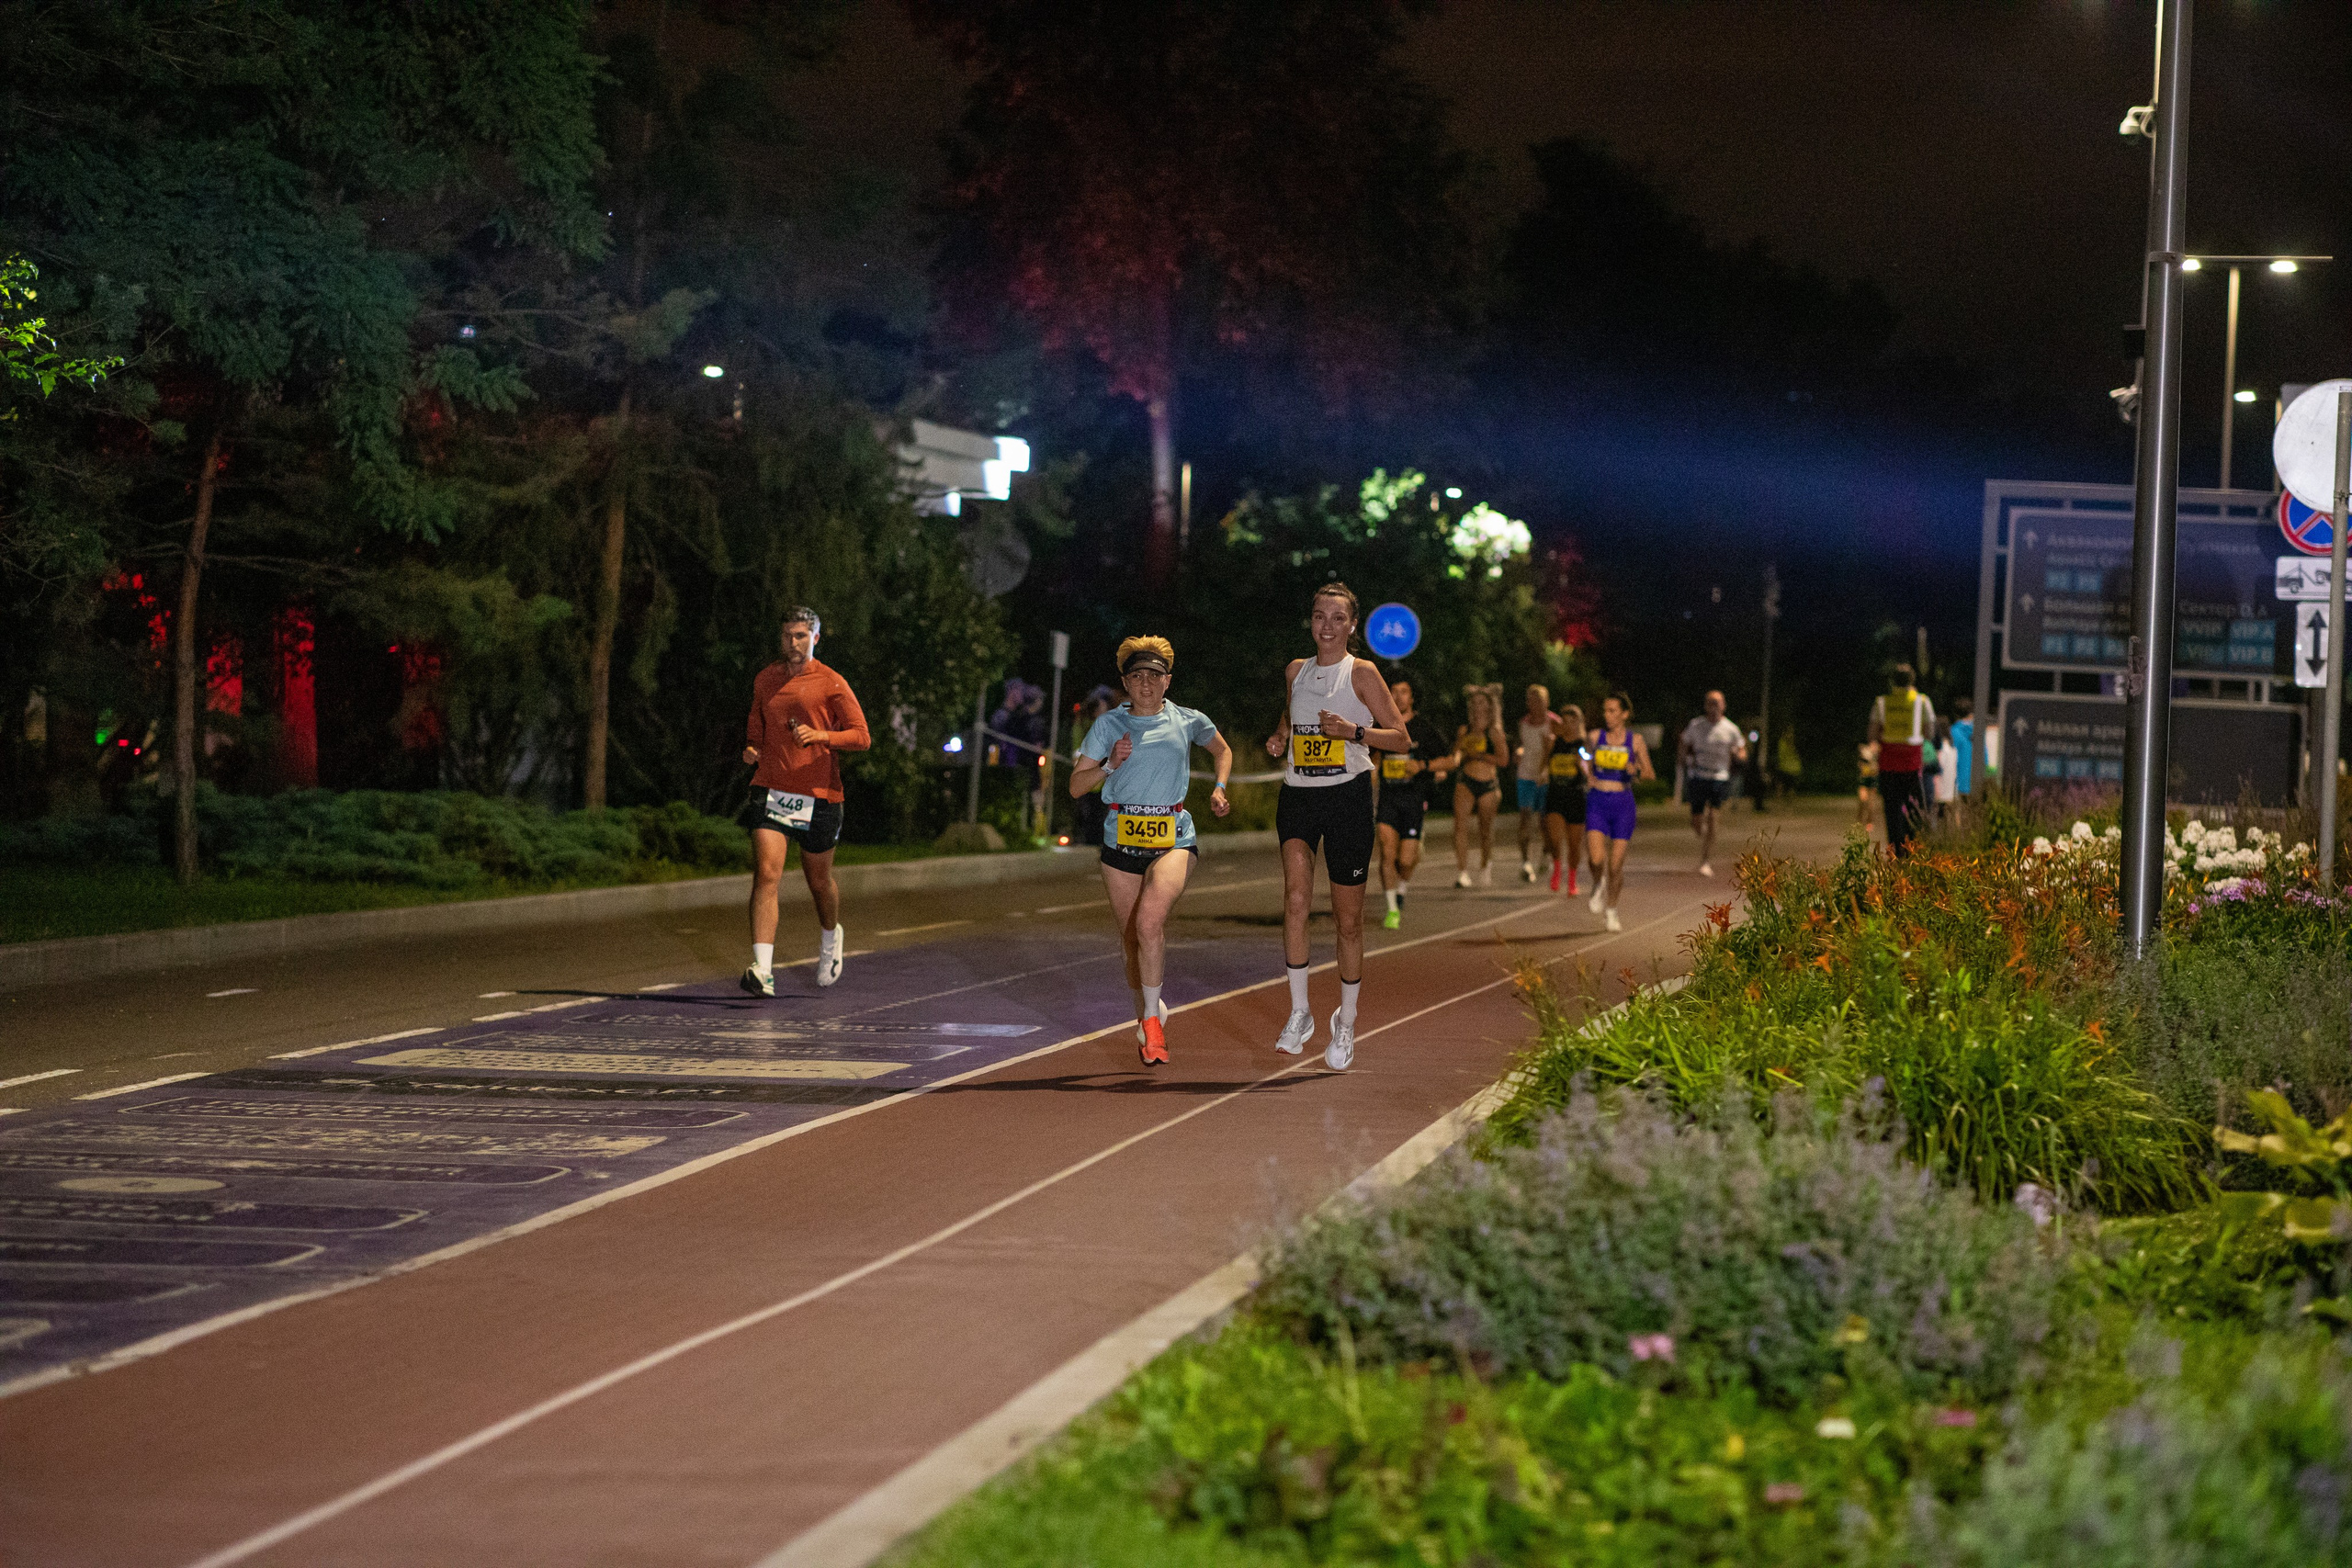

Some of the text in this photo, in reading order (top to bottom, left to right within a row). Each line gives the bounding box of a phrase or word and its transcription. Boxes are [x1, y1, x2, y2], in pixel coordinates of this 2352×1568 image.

[1304, 739, 1332, 756] 387
[777, 796, 804, 811] 448
[1125, 819, 1168, 838] 3450
